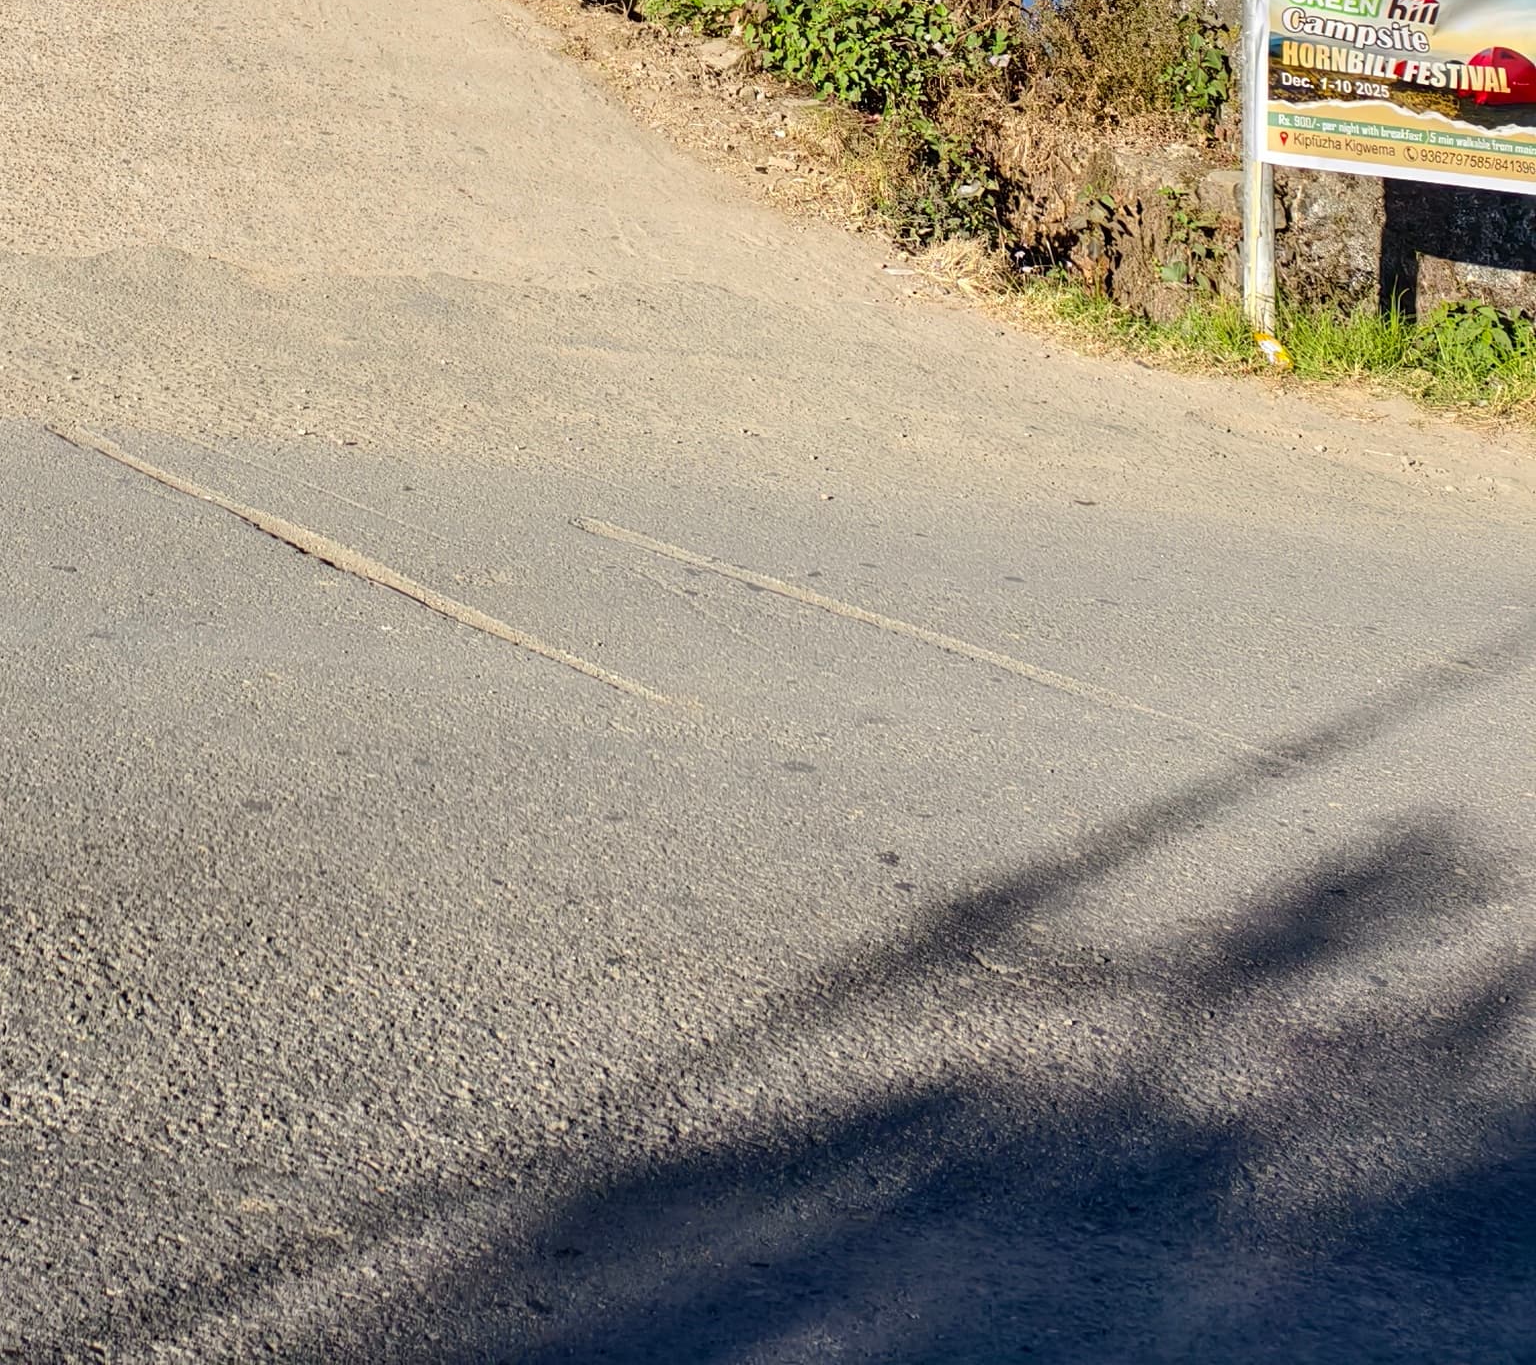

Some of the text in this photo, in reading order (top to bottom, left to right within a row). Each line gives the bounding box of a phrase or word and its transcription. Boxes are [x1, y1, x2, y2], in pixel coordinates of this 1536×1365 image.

[1281, 6, 1430, 53] Campsite
[1281, 40, 1511, 94] HORNBILL FESTIVAL
[1282, 72, 1390, 99] Dec. 1-10 2025
[1293, 132, 1342, 150] Kipfüzha
[1344, 138, 1396, 157] Kigwema
[1321, 123, 1337, 133] per
[1338, 122, 1360, 136] night
[1360, 125, 1379, 138] with
[1380, 126, 1423, 142] breakfast
[1438, 134, 1454, 146] min
[1455, 135, 1491, 150] walkable
[1492, 139, 1513, 152] from
